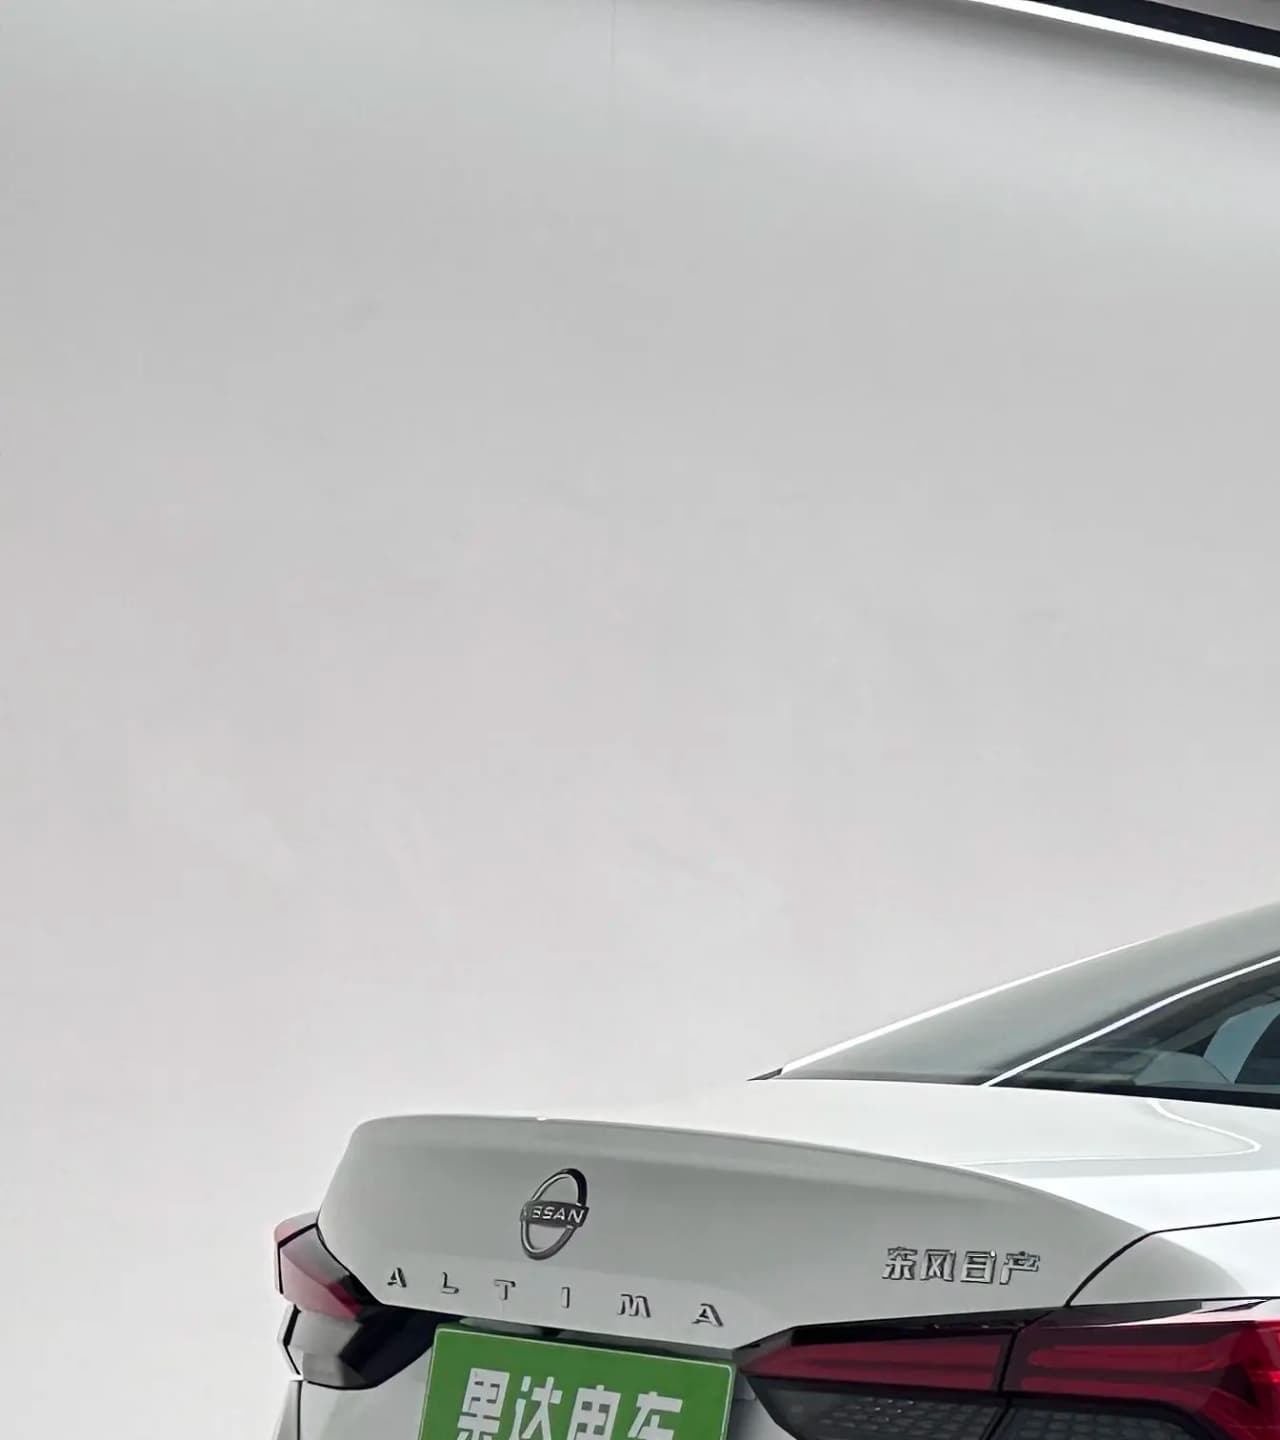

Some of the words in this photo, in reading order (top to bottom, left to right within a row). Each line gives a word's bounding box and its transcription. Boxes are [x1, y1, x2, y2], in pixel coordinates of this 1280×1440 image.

[881, 1246, 1041, 1286] 东风日产
[387, 1267, 724, 1328] ALTIMA
